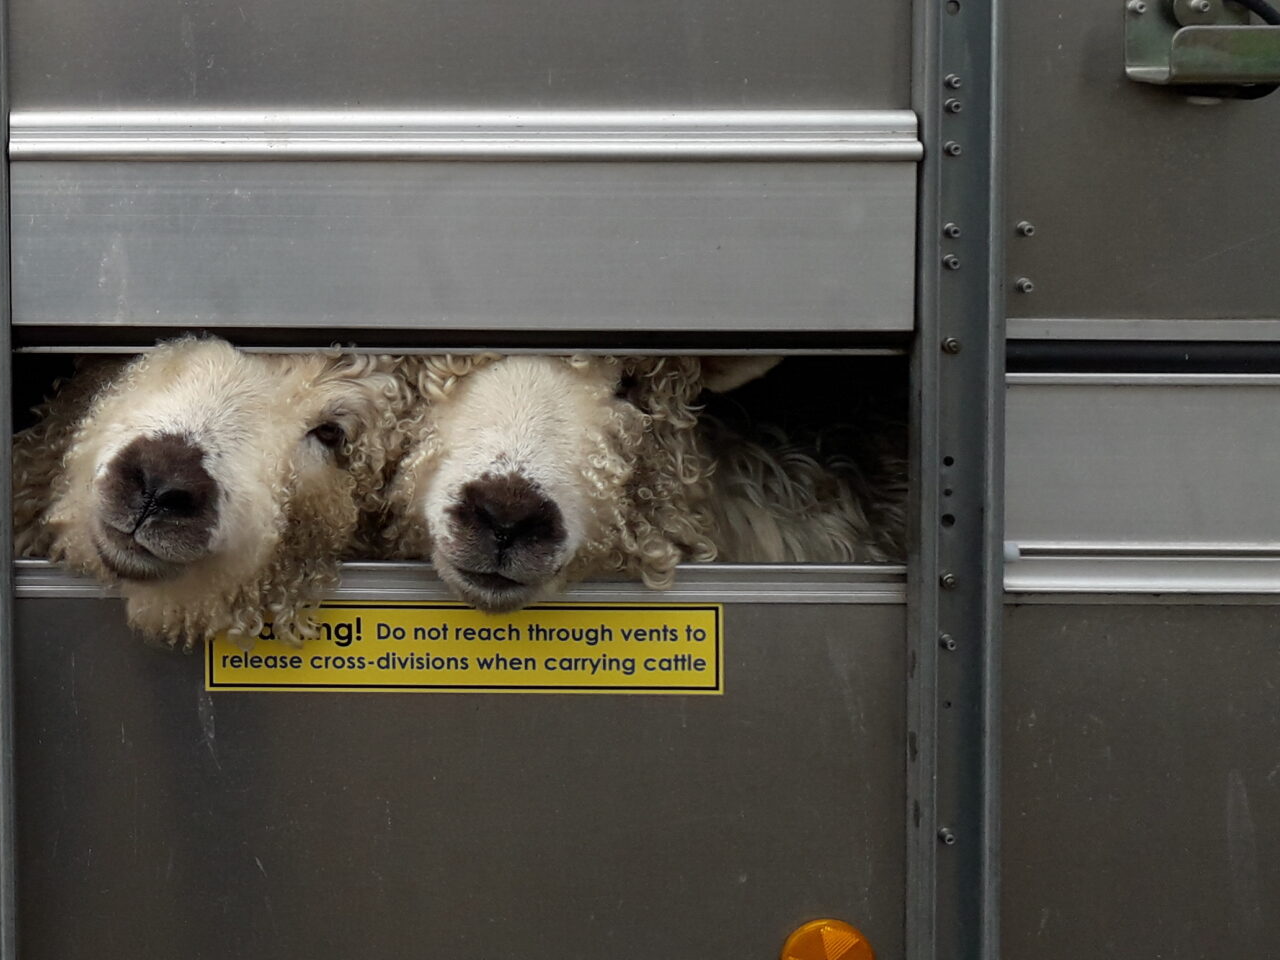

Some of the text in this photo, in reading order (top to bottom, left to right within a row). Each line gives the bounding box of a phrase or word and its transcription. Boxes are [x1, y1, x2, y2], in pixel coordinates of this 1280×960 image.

[376, 623, 406, 641] Do
[413, 623, 448, 641] not
[454, 623, 521, 642] reach
[527, 623, 613, 646] through
[620, 624, 679, 642] vents
[685, 624, 707, 642] to
[221, 650, 707, 675] release cross-divisions when carrying cattle
